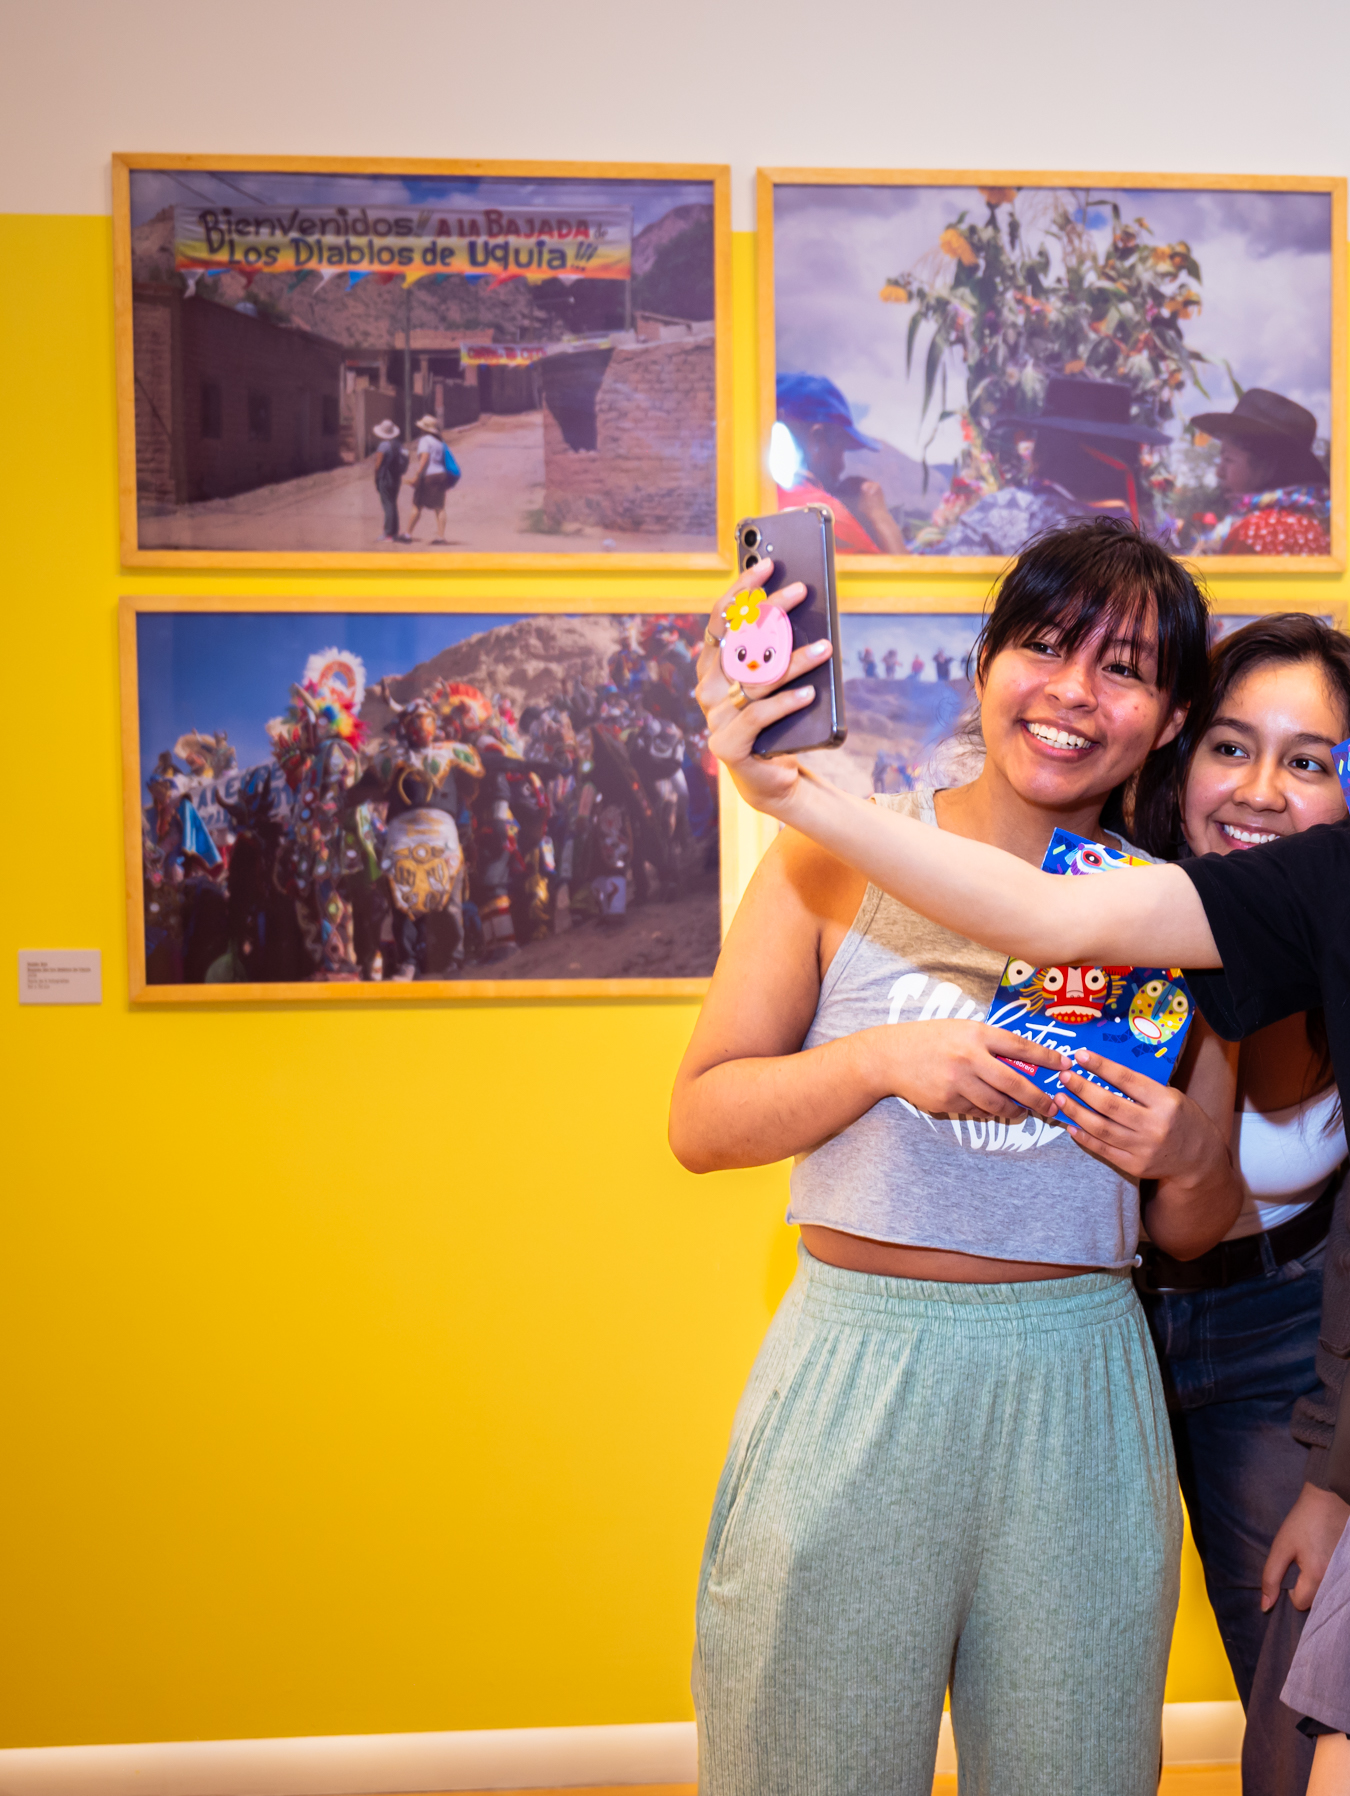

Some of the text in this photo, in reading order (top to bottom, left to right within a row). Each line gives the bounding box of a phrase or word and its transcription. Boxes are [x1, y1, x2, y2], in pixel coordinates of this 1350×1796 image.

[436, 217, 451, 240] A
[457, 217, 481, 240] LA
[483, 208, 591, 240] BAJADA
[228, 239, 280, 267] Los
[422, 240, 456, 267] de
